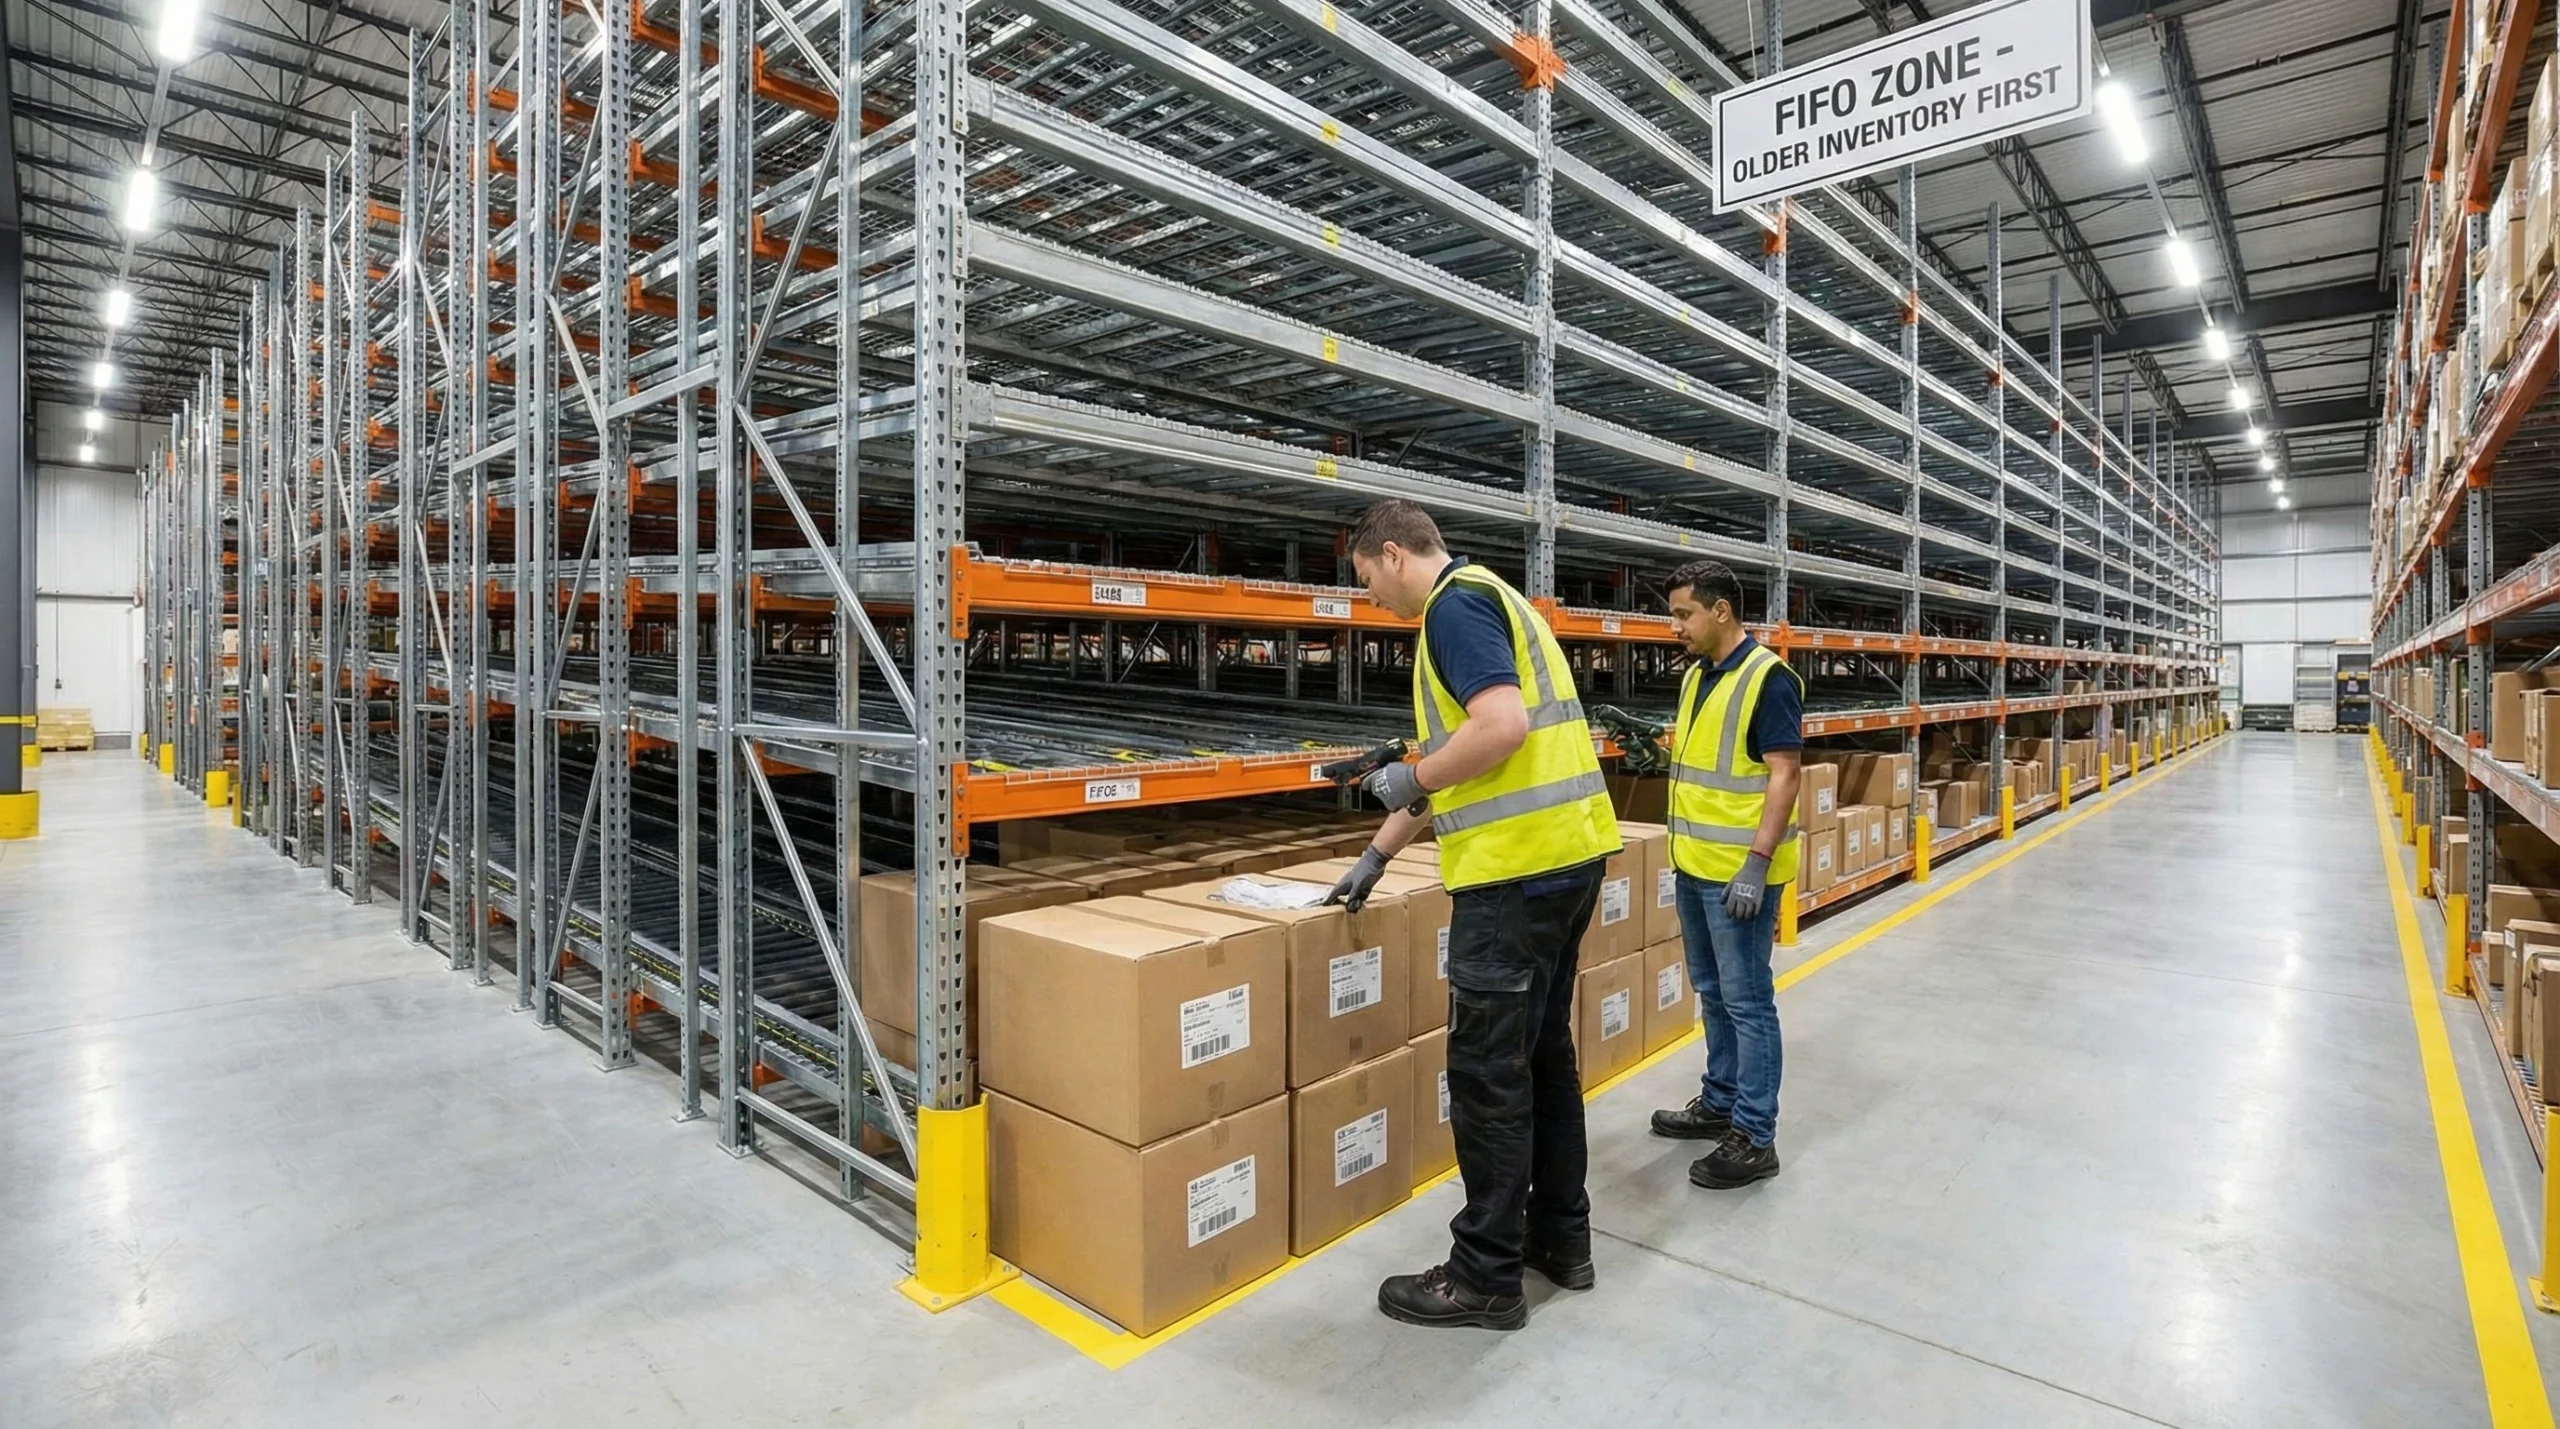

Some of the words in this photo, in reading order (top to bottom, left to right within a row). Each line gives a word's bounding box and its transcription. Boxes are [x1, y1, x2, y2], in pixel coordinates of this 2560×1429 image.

[1733, 142, 1809, 183] OLDER
[1819, 93, 1967, 160] INVENTORY
[1977, 66, 2062, 114] FIRST
[1776, 78, 1857, 135] FIFO
[1871, 36, 1981, 106] ZONE
[1996, 44, 2014, 57] -
